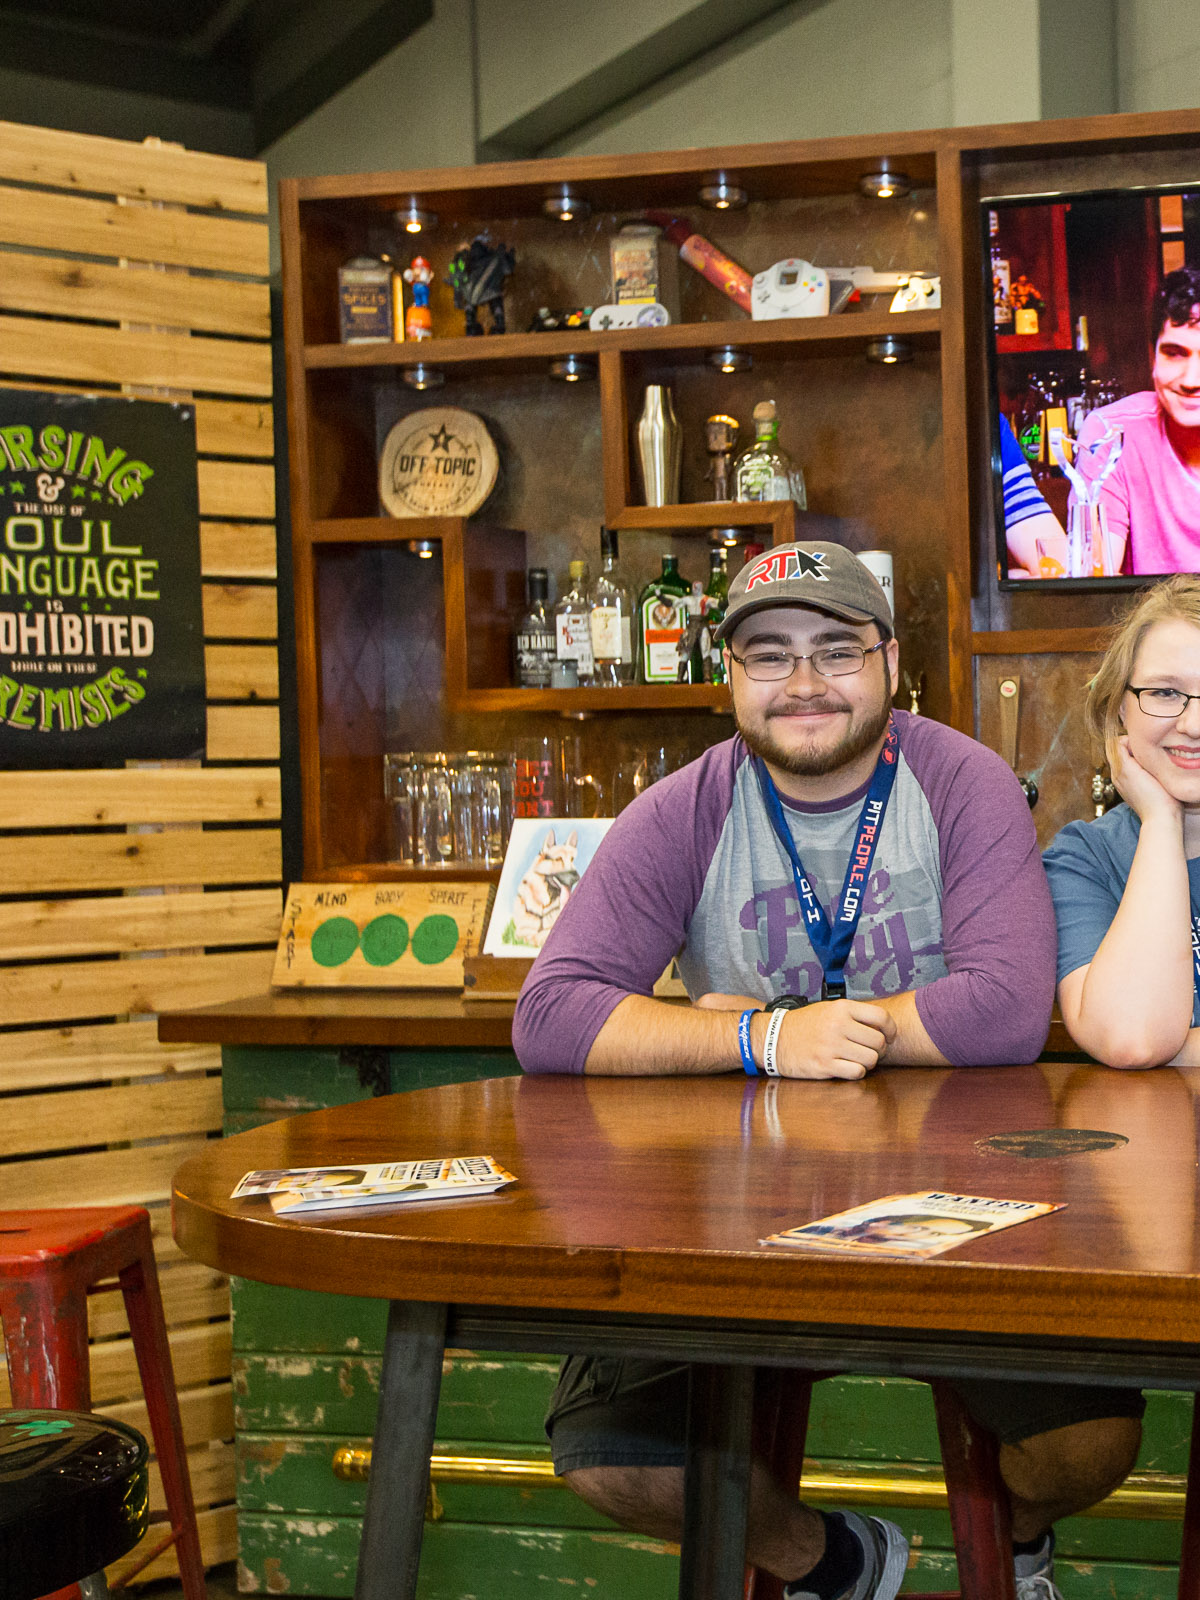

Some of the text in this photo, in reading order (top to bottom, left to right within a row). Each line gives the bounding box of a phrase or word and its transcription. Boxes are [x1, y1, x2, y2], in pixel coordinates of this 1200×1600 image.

[0, 424, 154, 505] RSING
[399, 455, 477, 476] OFF TOPIC
[36, 472, 66, 502] &
[14, 502, 85, 516] THE USE OF
[745, 548, 831, 593] RTX
[46, 600, 64, 613] IS
[11, 661, 97, 674] WHILE ON THESE
[839, 800, 883, 923] PITPEOPLE.COM
[314, 889, 469, 907] MIND BODY SPIRIT
[285, 898, 302, 969] START
[927, 1192, 1036, 1210] WANTED
